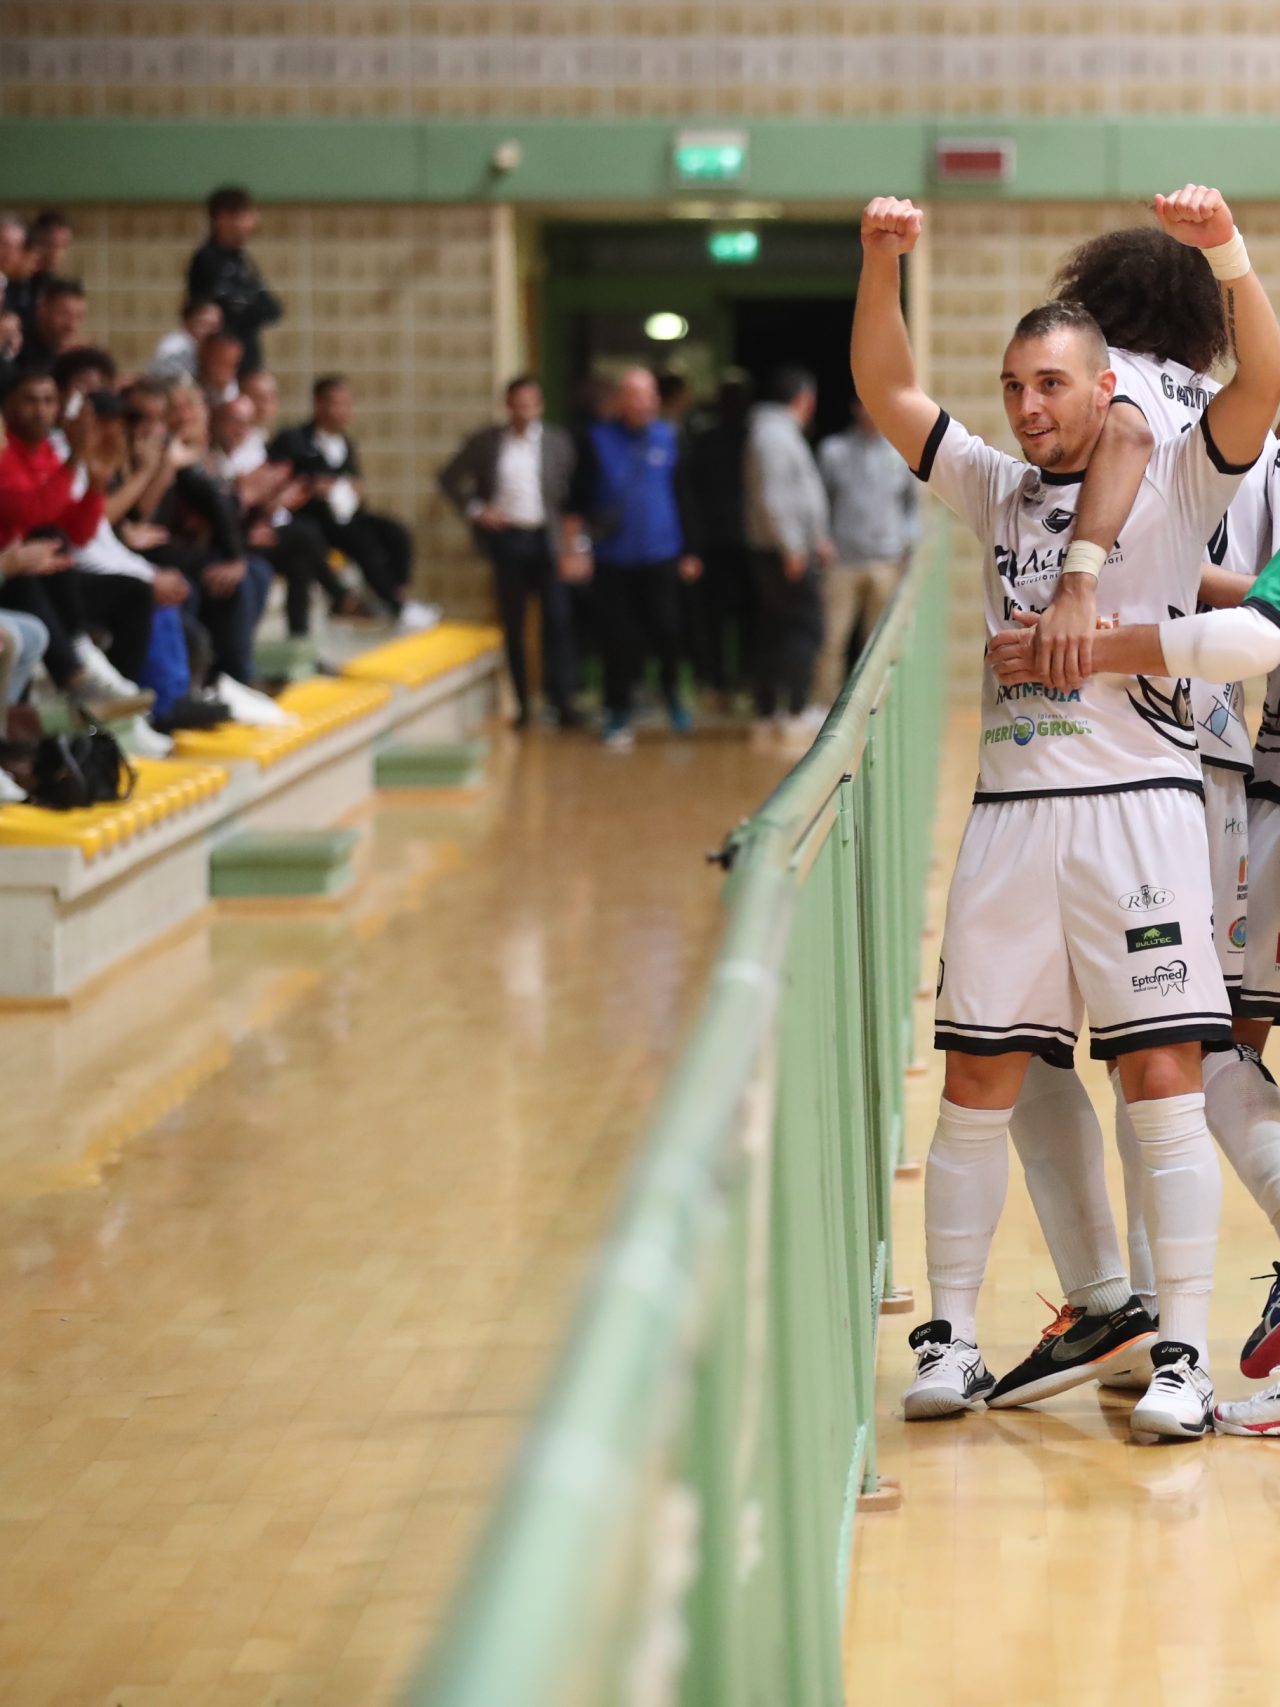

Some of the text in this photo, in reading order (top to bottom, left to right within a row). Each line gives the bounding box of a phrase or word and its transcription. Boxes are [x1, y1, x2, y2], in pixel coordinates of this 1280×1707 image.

[1128, 890, 1166, 908] R G
[1131, 968, 1183, 988] Eptamed
